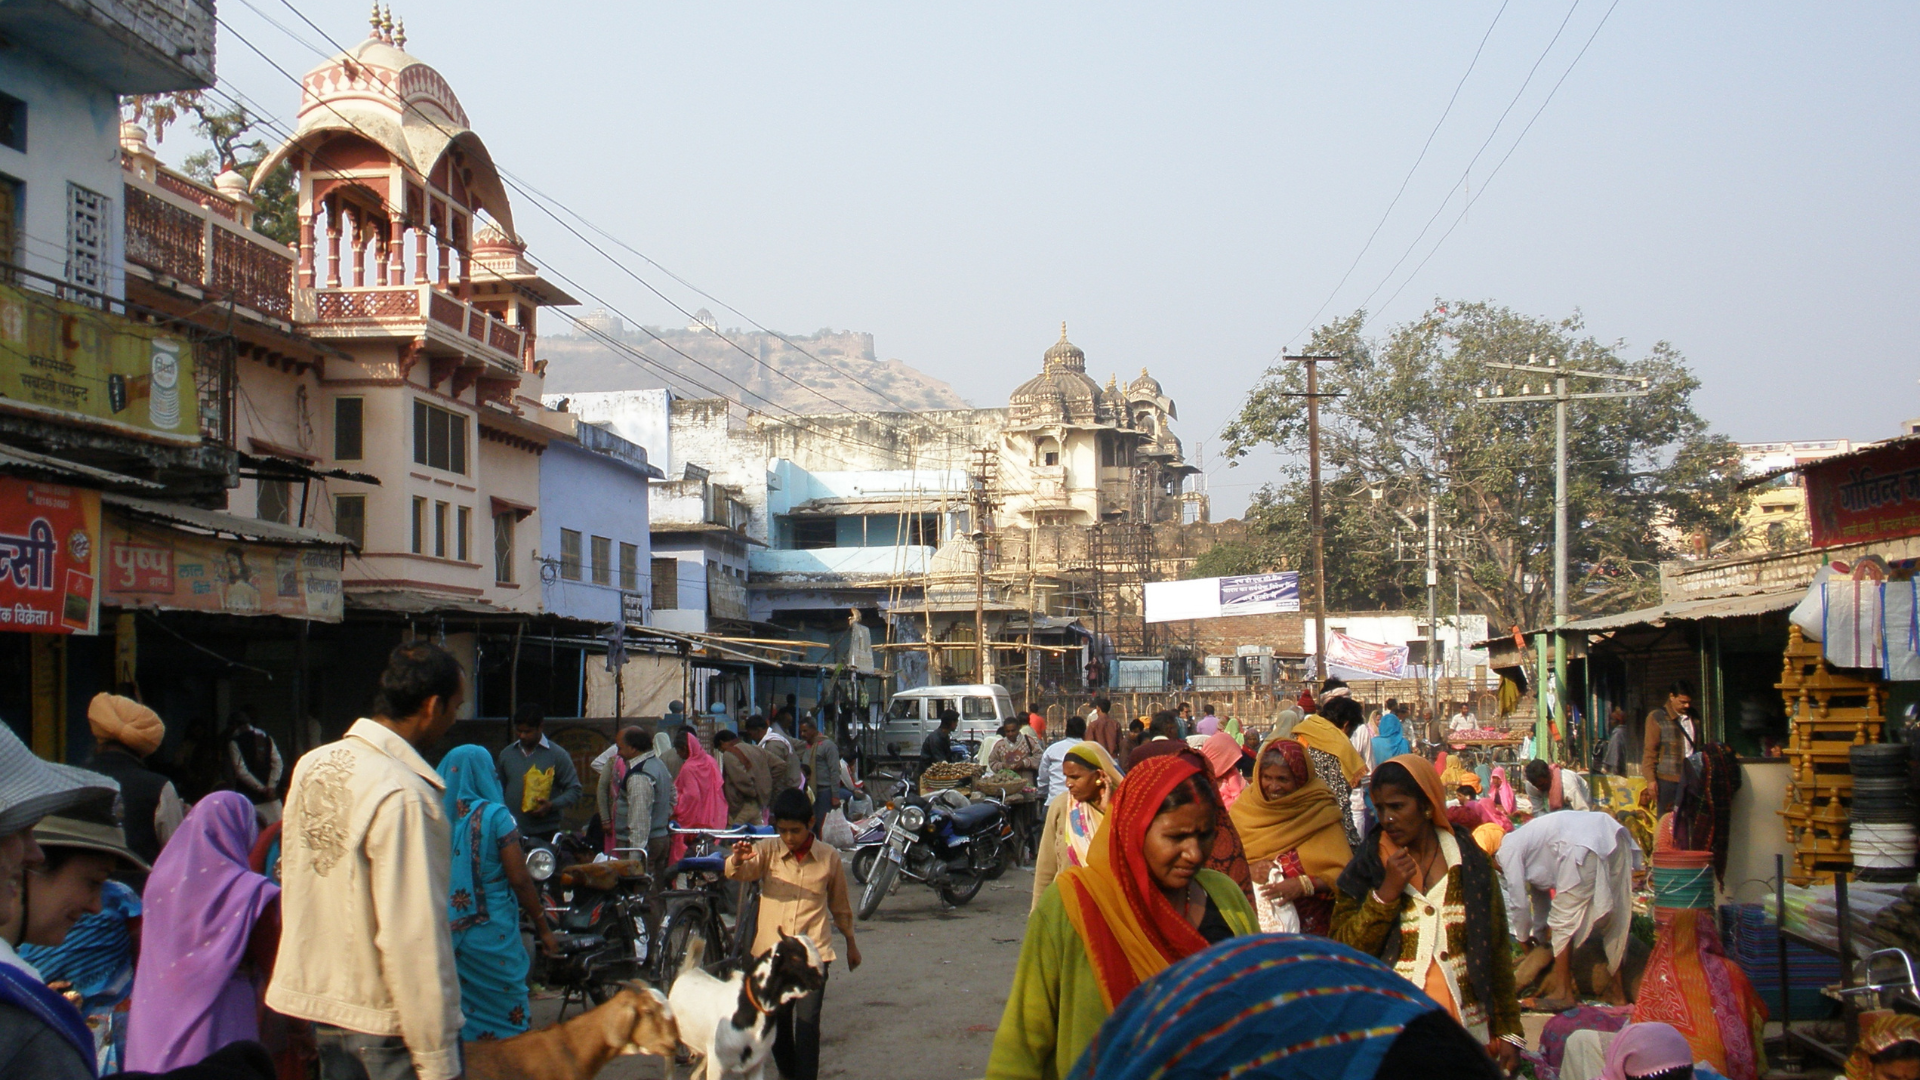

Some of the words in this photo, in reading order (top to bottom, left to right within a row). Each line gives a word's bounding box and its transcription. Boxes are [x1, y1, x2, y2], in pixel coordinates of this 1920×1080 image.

[113, 546, 170, 588] पुष्प
[177, 564, 204, 578] लाल
[1617, 787, 1634, 806] 3
